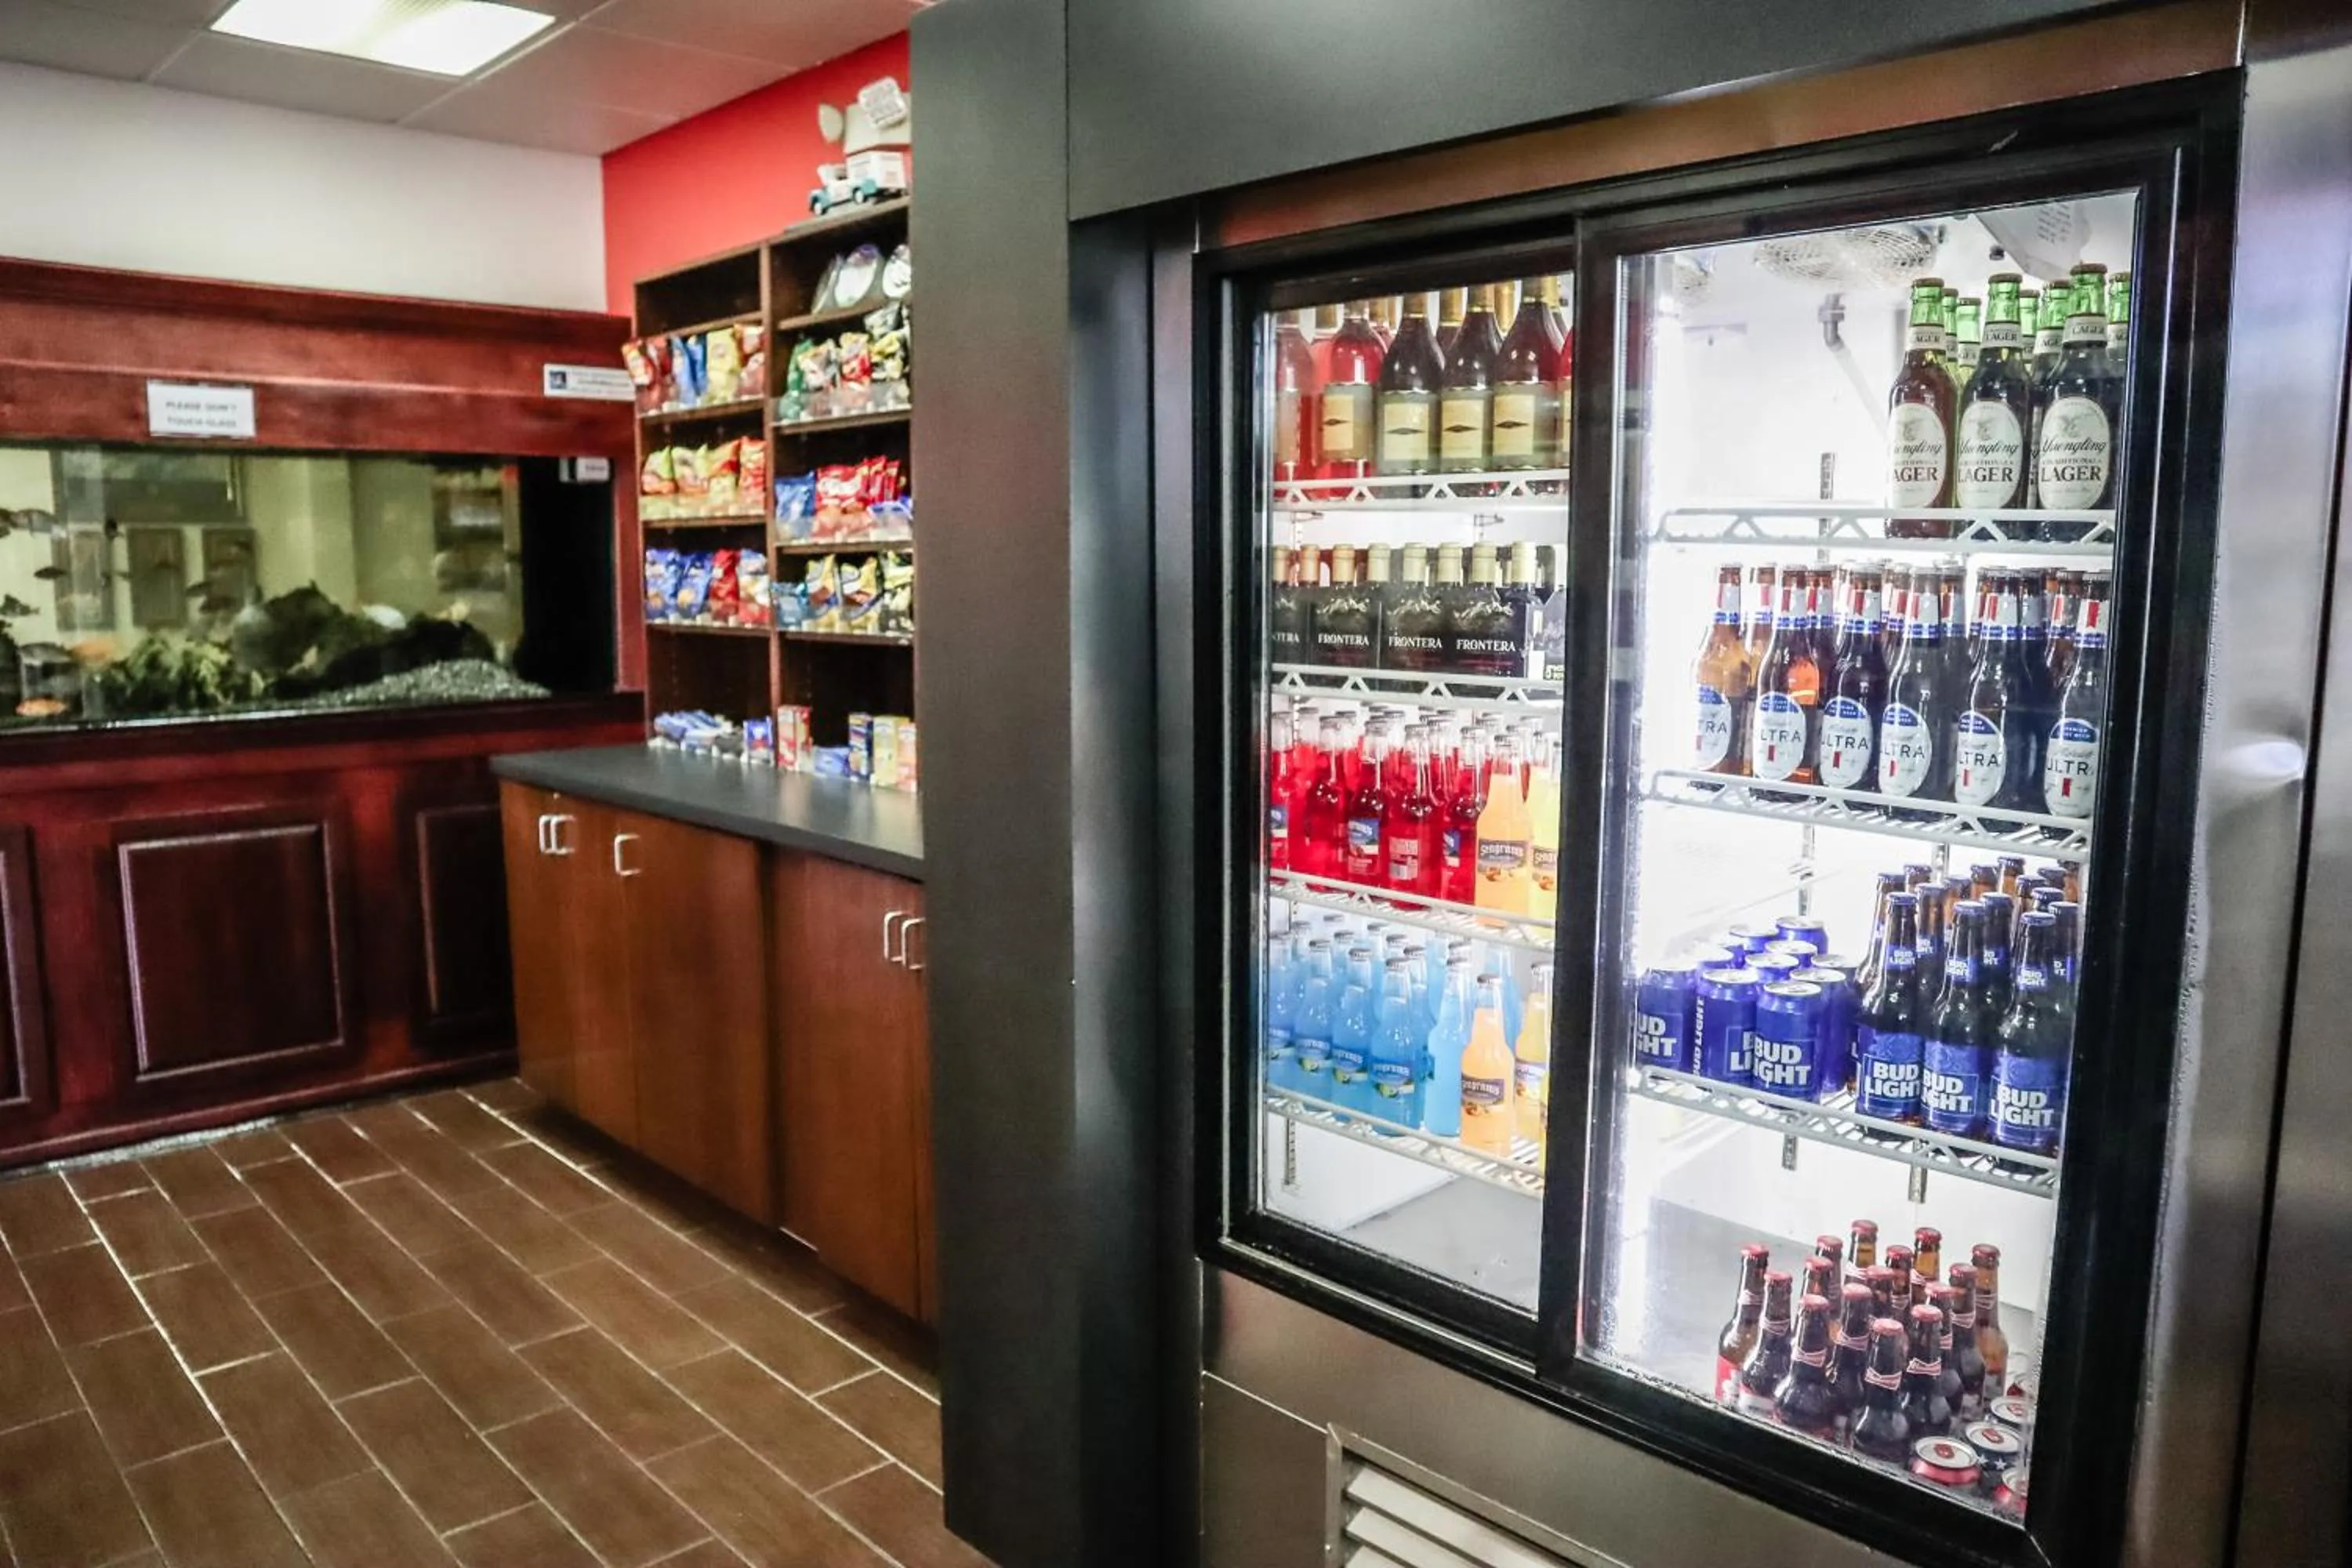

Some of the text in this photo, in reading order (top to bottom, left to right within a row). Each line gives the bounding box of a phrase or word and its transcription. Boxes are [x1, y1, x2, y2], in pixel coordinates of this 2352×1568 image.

[1915, 335, 1940, 343] AGER
[1986, 332, 2017, 342] LAGER
[2042, 437, 2107, 456] Yuengling
[1893, 466, 1938, 482] AGER
[1958, 466, 2013, 483] LAGER
[2041, 466, 2101, 482] LAGER
[1317, 633, 1370, 648] FRONTERA
[1388, 635, 1443, 650] FRONTERA
[1456, 638, 1516, 653] FRONTERA
[1698, 719, 1728, 734] TRA
[1760, 728, 1802, 742] LTRA
[1880, 743, 1925, 759] LTRA
[1959, 752, 1999, 768] LTRA
[2046, 757, 2095, 776] ULTR
[1638, 1014, 1666, 1036] UD
[1636, 1033, 1677, 1057] GHT
[1754, 1036, 1802, 1065] BUD
[1753, 1059, 1812, 1086] IGHT
[1873, 1061, 1919, 1081] BUD
[1923, 1069, 1964, 1094] BUD
[1922, 1086, 1973, 1113] IGHT
[1997, 1083, 2048, 1109] BUD
[1991, 1098, 2055, 1127] LIGHT
